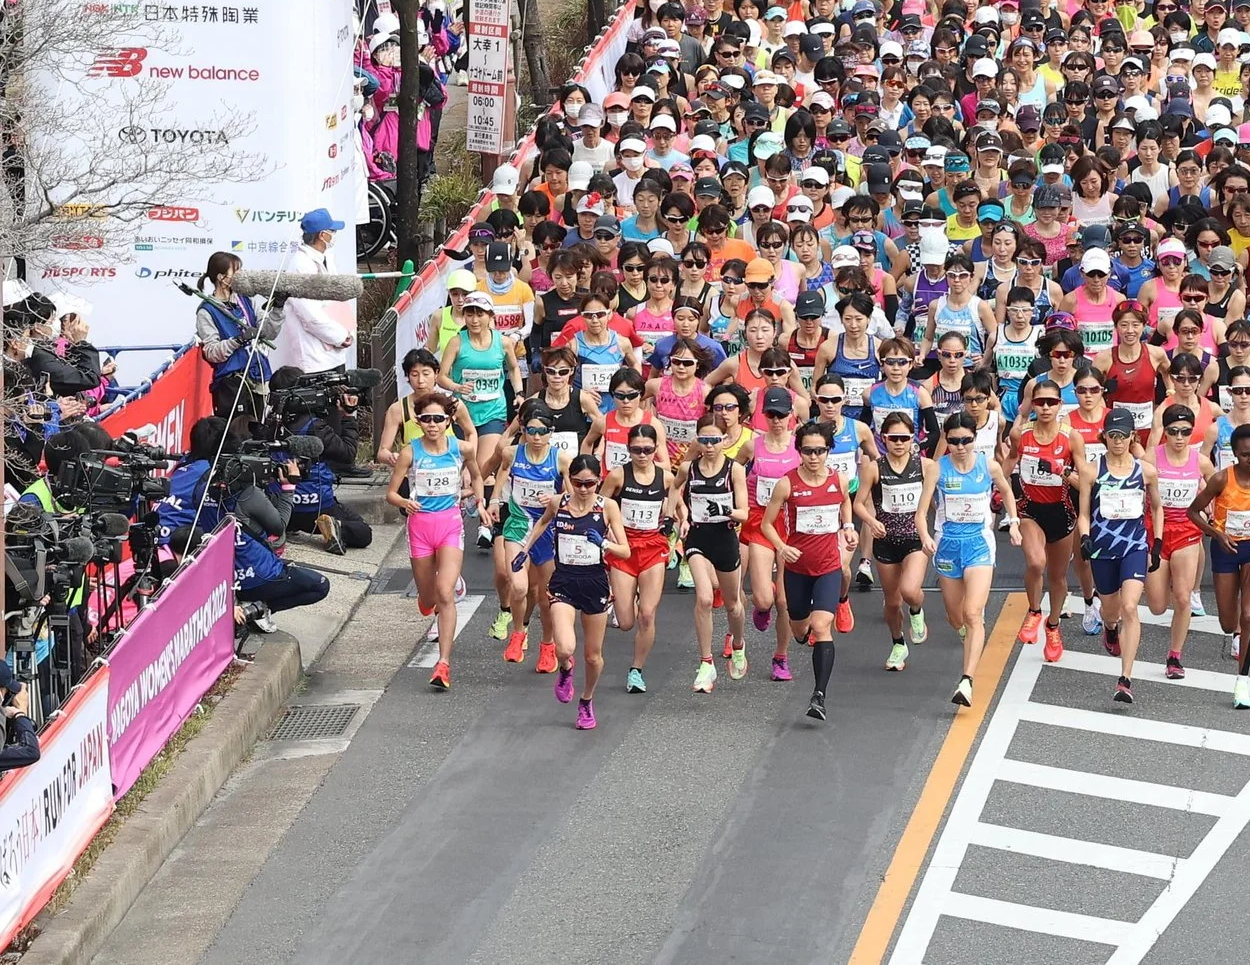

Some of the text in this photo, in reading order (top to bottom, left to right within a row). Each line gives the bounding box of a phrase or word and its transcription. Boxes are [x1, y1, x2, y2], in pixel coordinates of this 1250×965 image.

[144, 4, 260, 24] 日本特殊陶業
[473, 37, 492, 52] 大幸
[150, 65, 260, 81] new balance
[473, 95, 495, 108] 06:00
[473, 115, 495, 127] 10:45
[150, 128, 230, 146] TOYOTA
[149, 207, 199, 221] フジパン
[154, 268, 203, 280] phite
[1084, 331, 1113, 343] 10105
[666, 425, 688, 436] 153
[425, 476, 450, 488] 128
[625, 486, 643, 494] DENSO
[1165, 488, 1190, 498] 107
[890, 492, 914, 503] 110
[964, 502, 972, 513] 2
[1120, 499, 1125, 509] 1
[629, 509, 653, 520] 113
[815, 514, 823, 525] 3
[575, 544, 583, 555] 5
[111, 579, 229, 747] NAGOYA WOMEN'S MARATHON 2022
[43, 775, 63, 837] RUN
[62, 751, 77, 813] FOR
[78, 721, 104, 789] JAPAN
